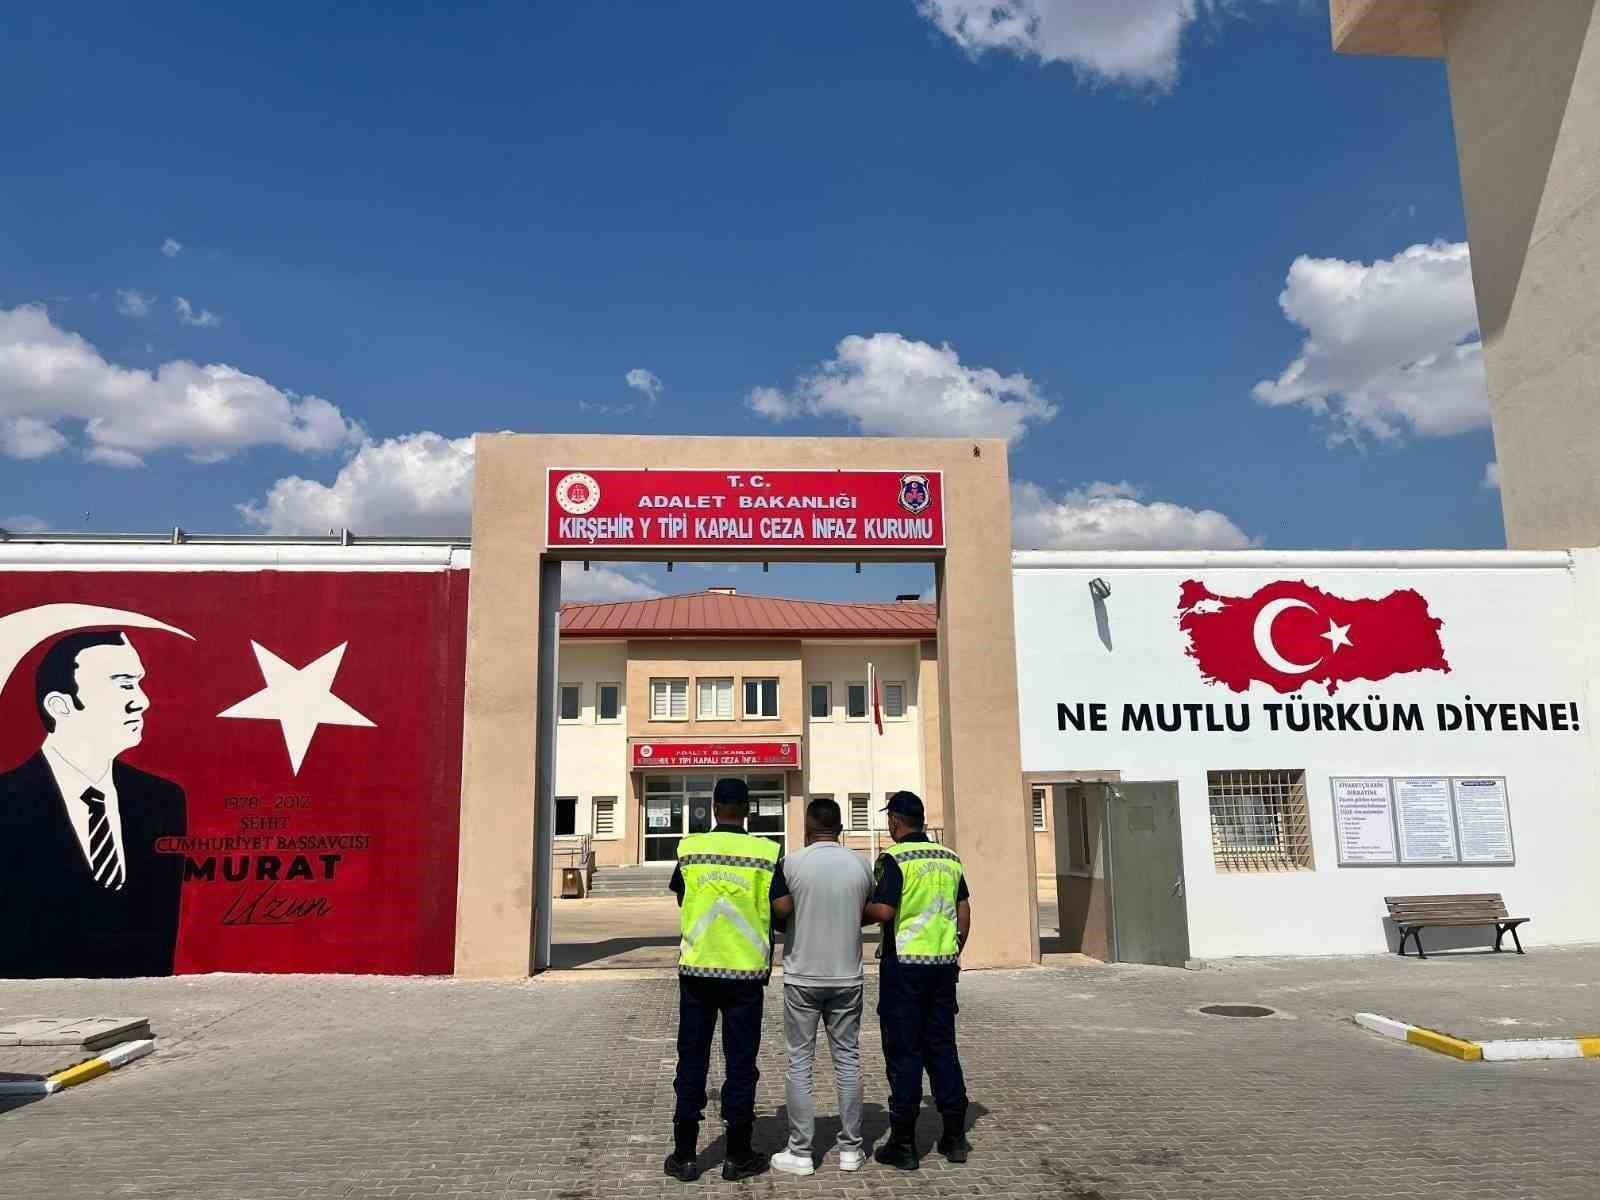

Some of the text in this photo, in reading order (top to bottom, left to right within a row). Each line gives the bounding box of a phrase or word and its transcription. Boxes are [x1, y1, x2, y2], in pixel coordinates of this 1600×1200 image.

[726, 475, 771, 488] T. C.
[637, 493, 857, 509] ADALET BAKANLIĞI
[559, 513, 933, 543] KIRŞEHİR Y TİPİ KAPALI CEZA İNFAZ KURUMU
[1057, 694, 1580, 732] NE MUTLU TÜRKÜM DİYENE!
[184, 854, 342, 882] MURAT
[221, 881, 333, 926] Uzun
